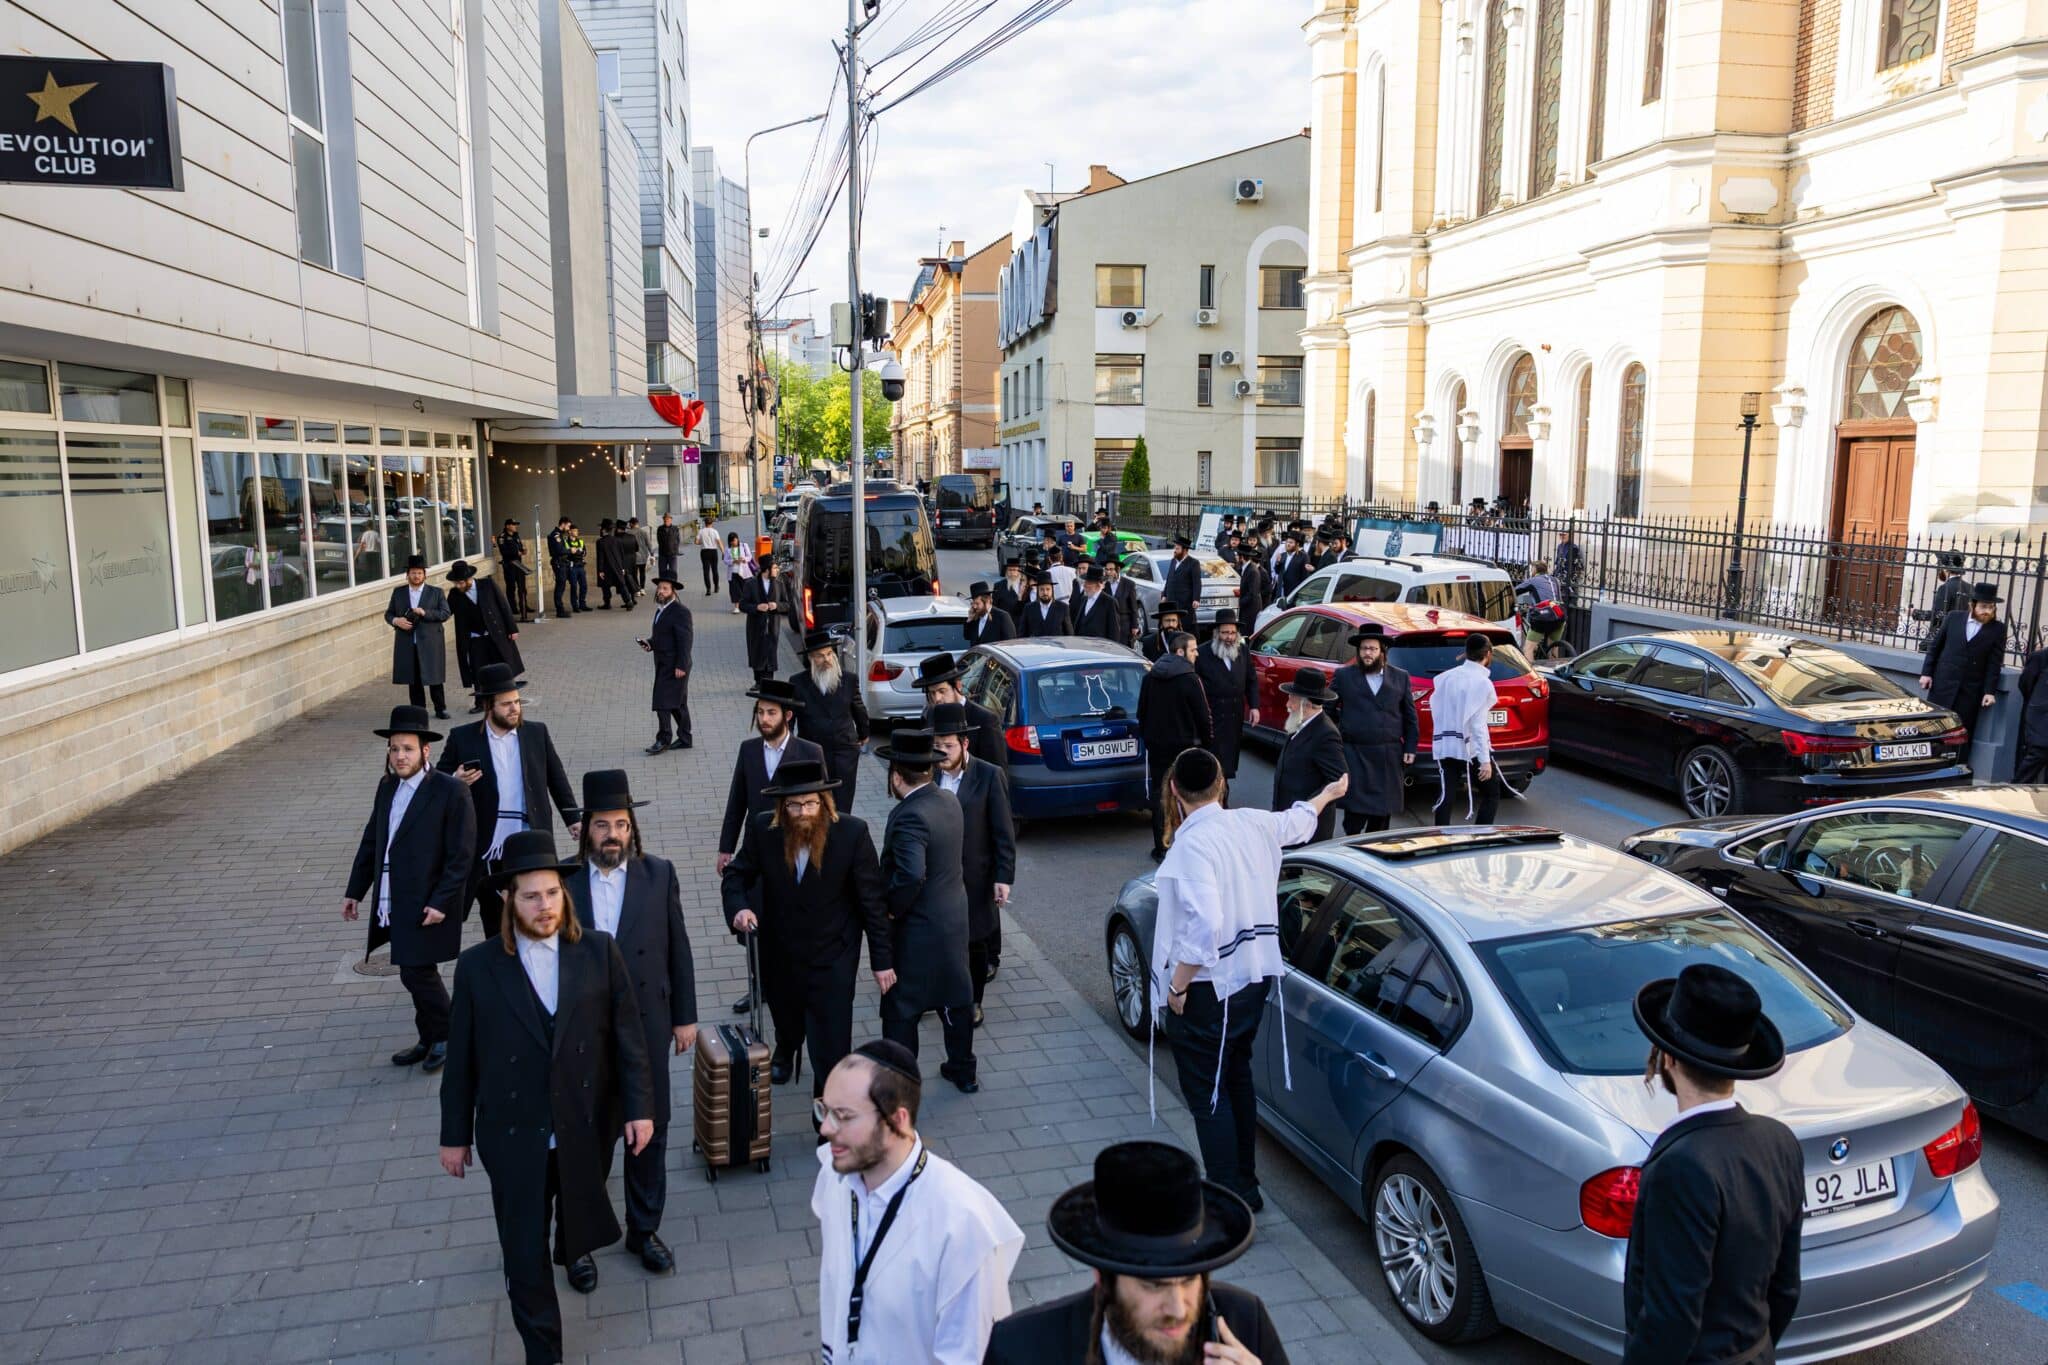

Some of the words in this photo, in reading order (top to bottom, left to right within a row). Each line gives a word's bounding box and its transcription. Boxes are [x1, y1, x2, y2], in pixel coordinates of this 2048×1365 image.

[35, 156, 97, 175] CLUB
[775, 456, 782, 466] P
[1080, 745, 1095, 757] SM
[1881, 747, 1894, 758] SM
[1897, 746, 1909, 756] 04
[1912, 744, 1928, 755] KID
[1816, 1174, 1843, 1203] 92
[1854, 1163, 1889, 1196] JLA
